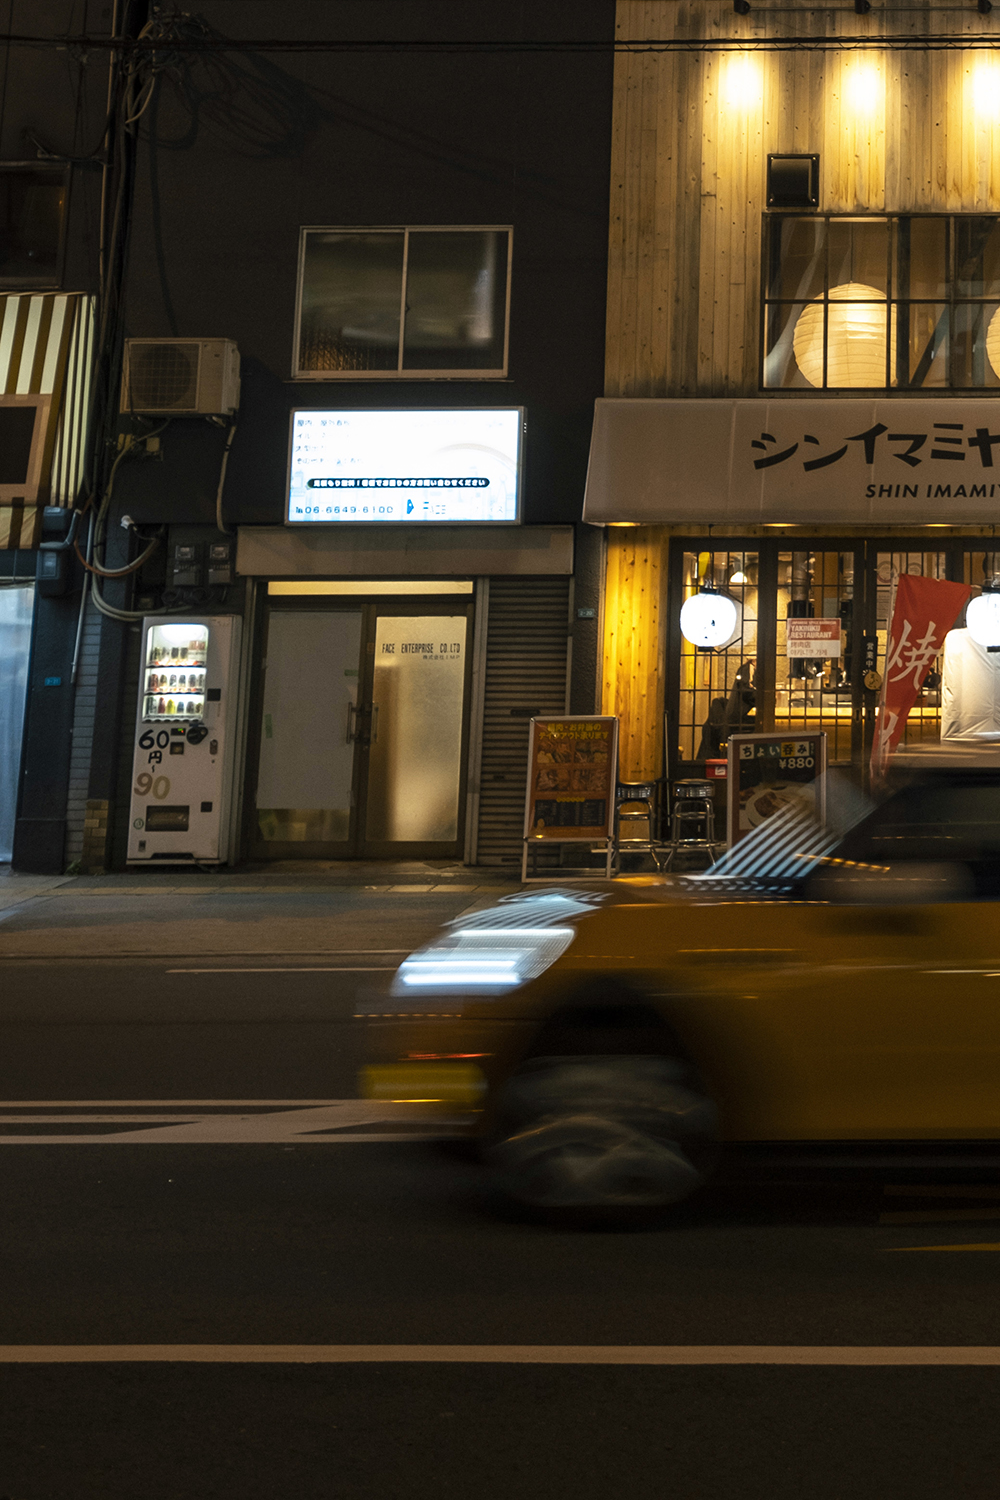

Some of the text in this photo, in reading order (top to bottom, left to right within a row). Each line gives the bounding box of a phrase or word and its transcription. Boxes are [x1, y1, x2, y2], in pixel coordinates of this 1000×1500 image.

[865, 484, 919, 498] SHIN
[381, 643, 396, 654] FACE
[400, 643, 434, 654] ENTERPRISE
[865, 641, 875, 668] 営業中
[138, 729, 170, 750] 60
[742, 744, 808, 757] ちょい呑み
[148, 751, 162, 764] 円
[779, 757, 815, 769] ¥880
[133, 772, 171, 800] 90
